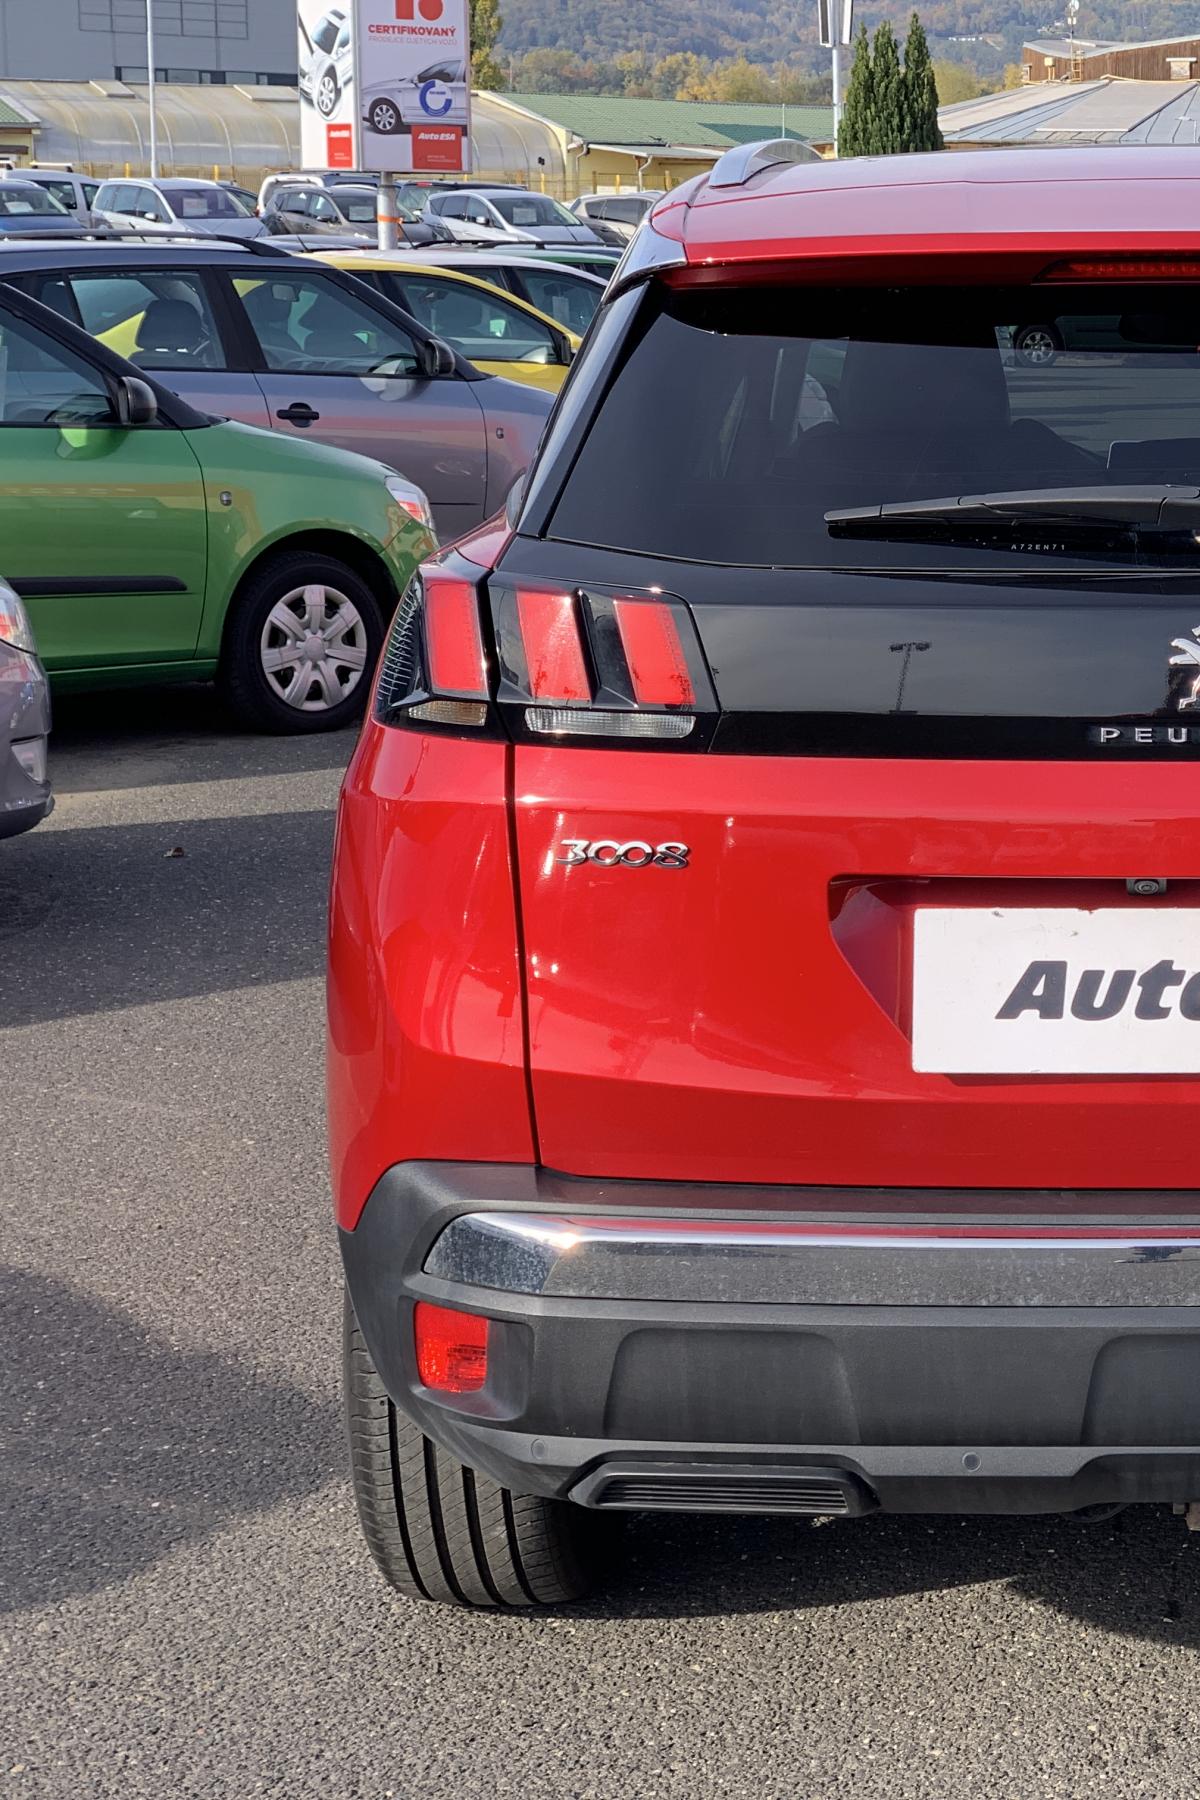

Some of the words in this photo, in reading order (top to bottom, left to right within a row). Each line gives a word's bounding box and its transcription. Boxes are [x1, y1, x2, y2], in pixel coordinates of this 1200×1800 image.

[368, 24, 456, 37] CERTIFIKOVANÝ
[418, 132, 439, 140] Auto
[439, 133, 456, 141] ESA
[1011, 543, 1065, 551] A72EN71
[556, 839, 689, 868] 3008
